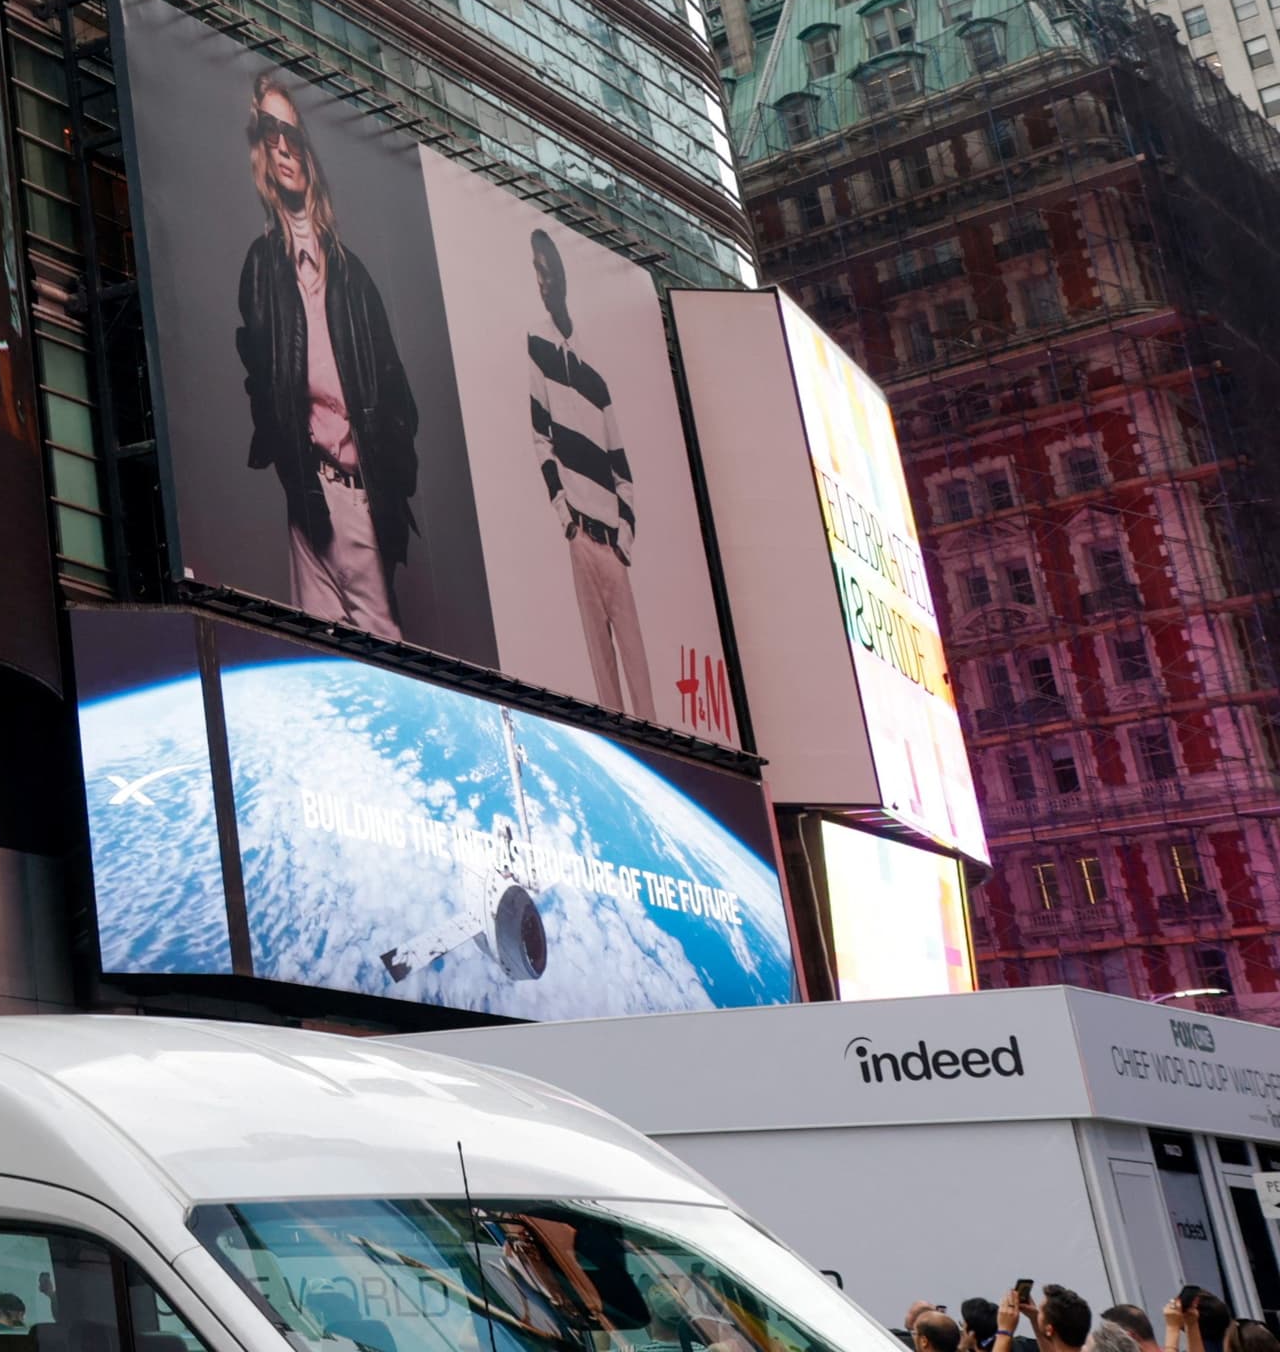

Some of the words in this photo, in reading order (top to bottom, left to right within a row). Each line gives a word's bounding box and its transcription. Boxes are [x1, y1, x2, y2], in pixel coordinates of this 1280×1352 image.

[675, 645, 732, 743] H&M
[301, 788, 407, 848] BUILDING
[406, 814, 453, 860] THE
[618, 865, 642, 901] OF
[640, 870, 680, 911] THE
[678, 879, 743, 925] FUTURE
[846, 1035, 1024, 1084] indeed
[1111, 1045, 1151, 1080] CHIEF
[1150, 1052, 1202, 1088] WORLD
[1201, 1060, 1229, 1091] CUP
[1228, 1065, 1280, 1101] WATCHE
